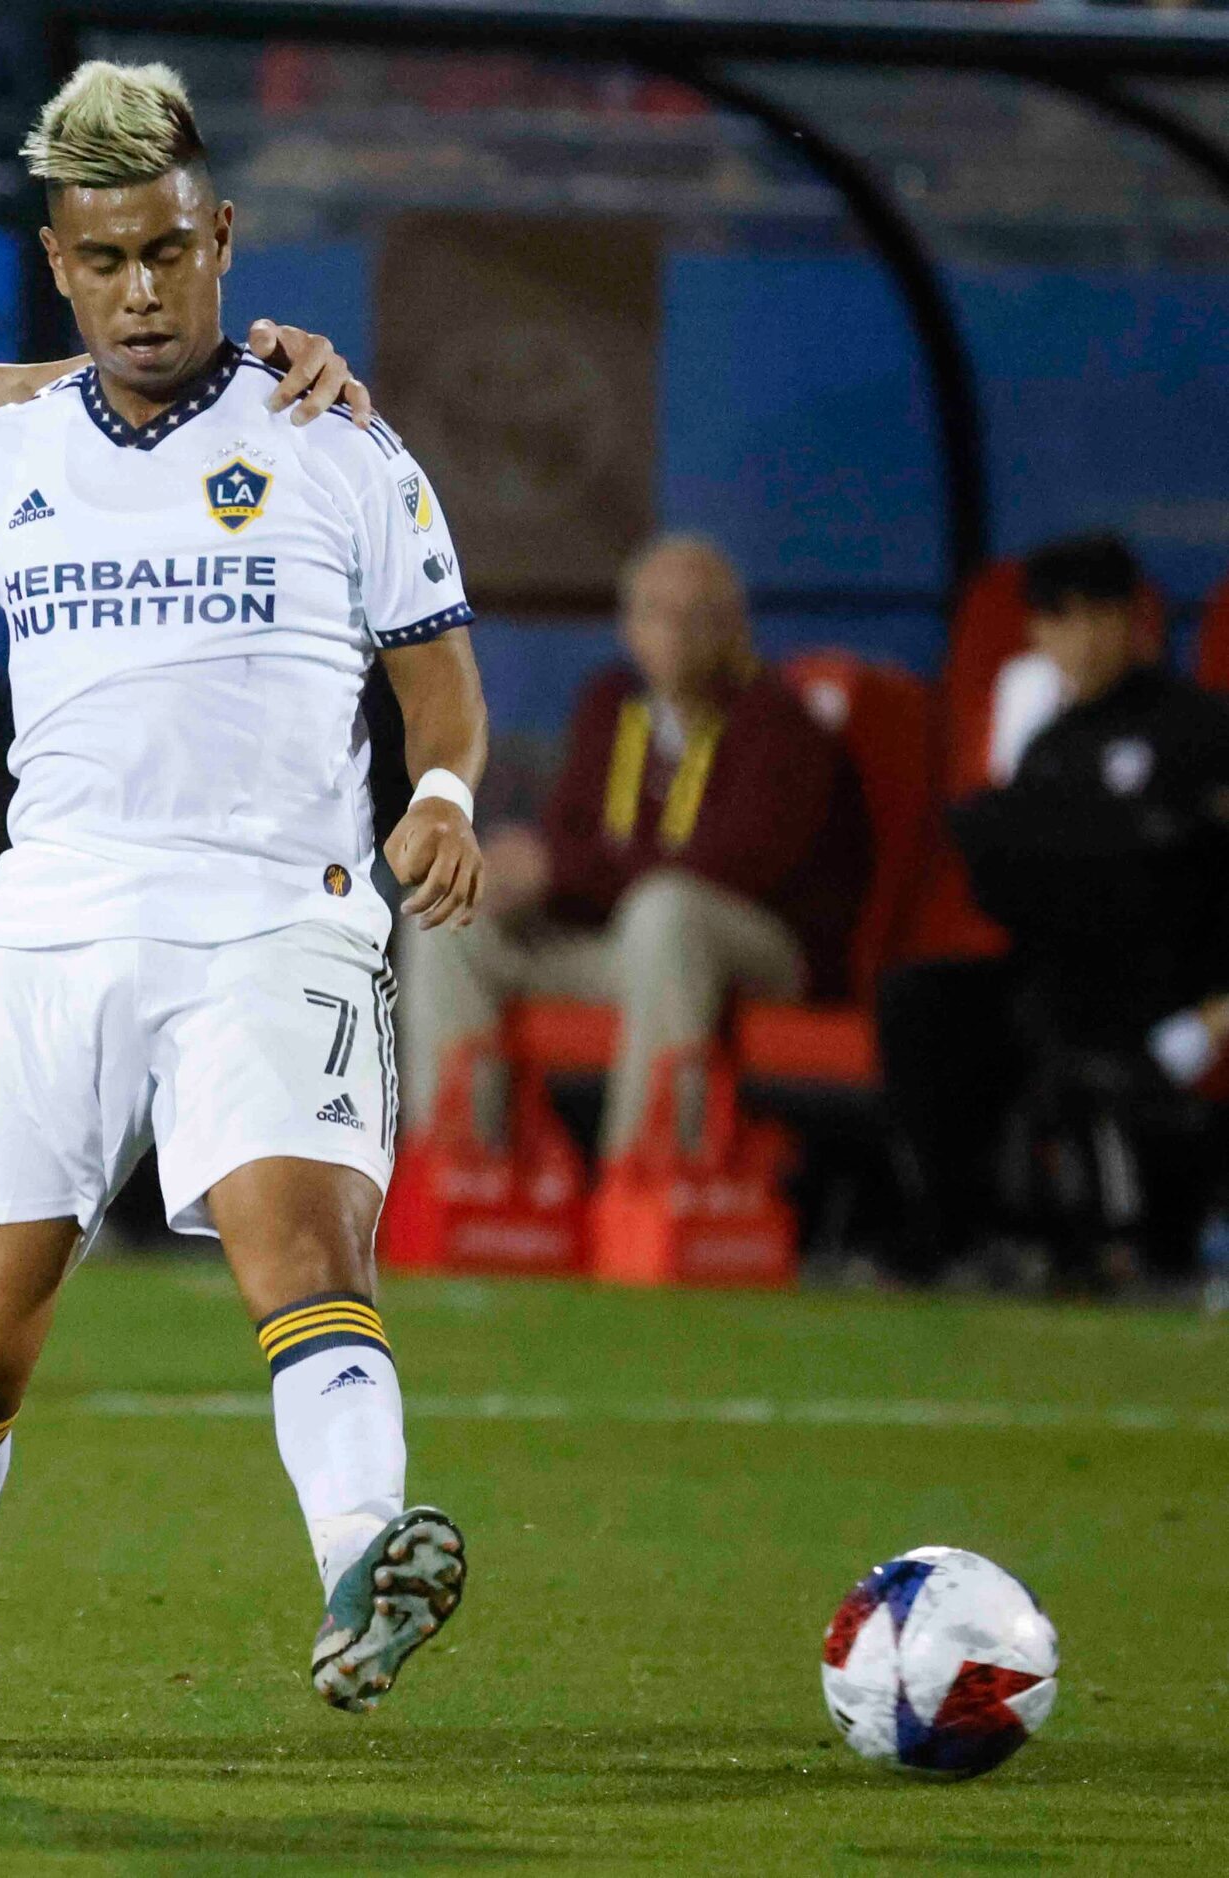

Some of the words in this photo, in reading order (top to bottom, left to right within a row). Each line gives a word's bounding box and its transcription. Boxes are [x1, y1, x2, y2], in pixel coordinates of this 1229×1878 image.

[216, 483, 256, 504] LA
[8, 507, 55, 529] adidas
[5, 556, 276, 604] HERBALIFE
[12, 594, 276, 642] NUTRITION
[303, 988, 358, 1077] 7
